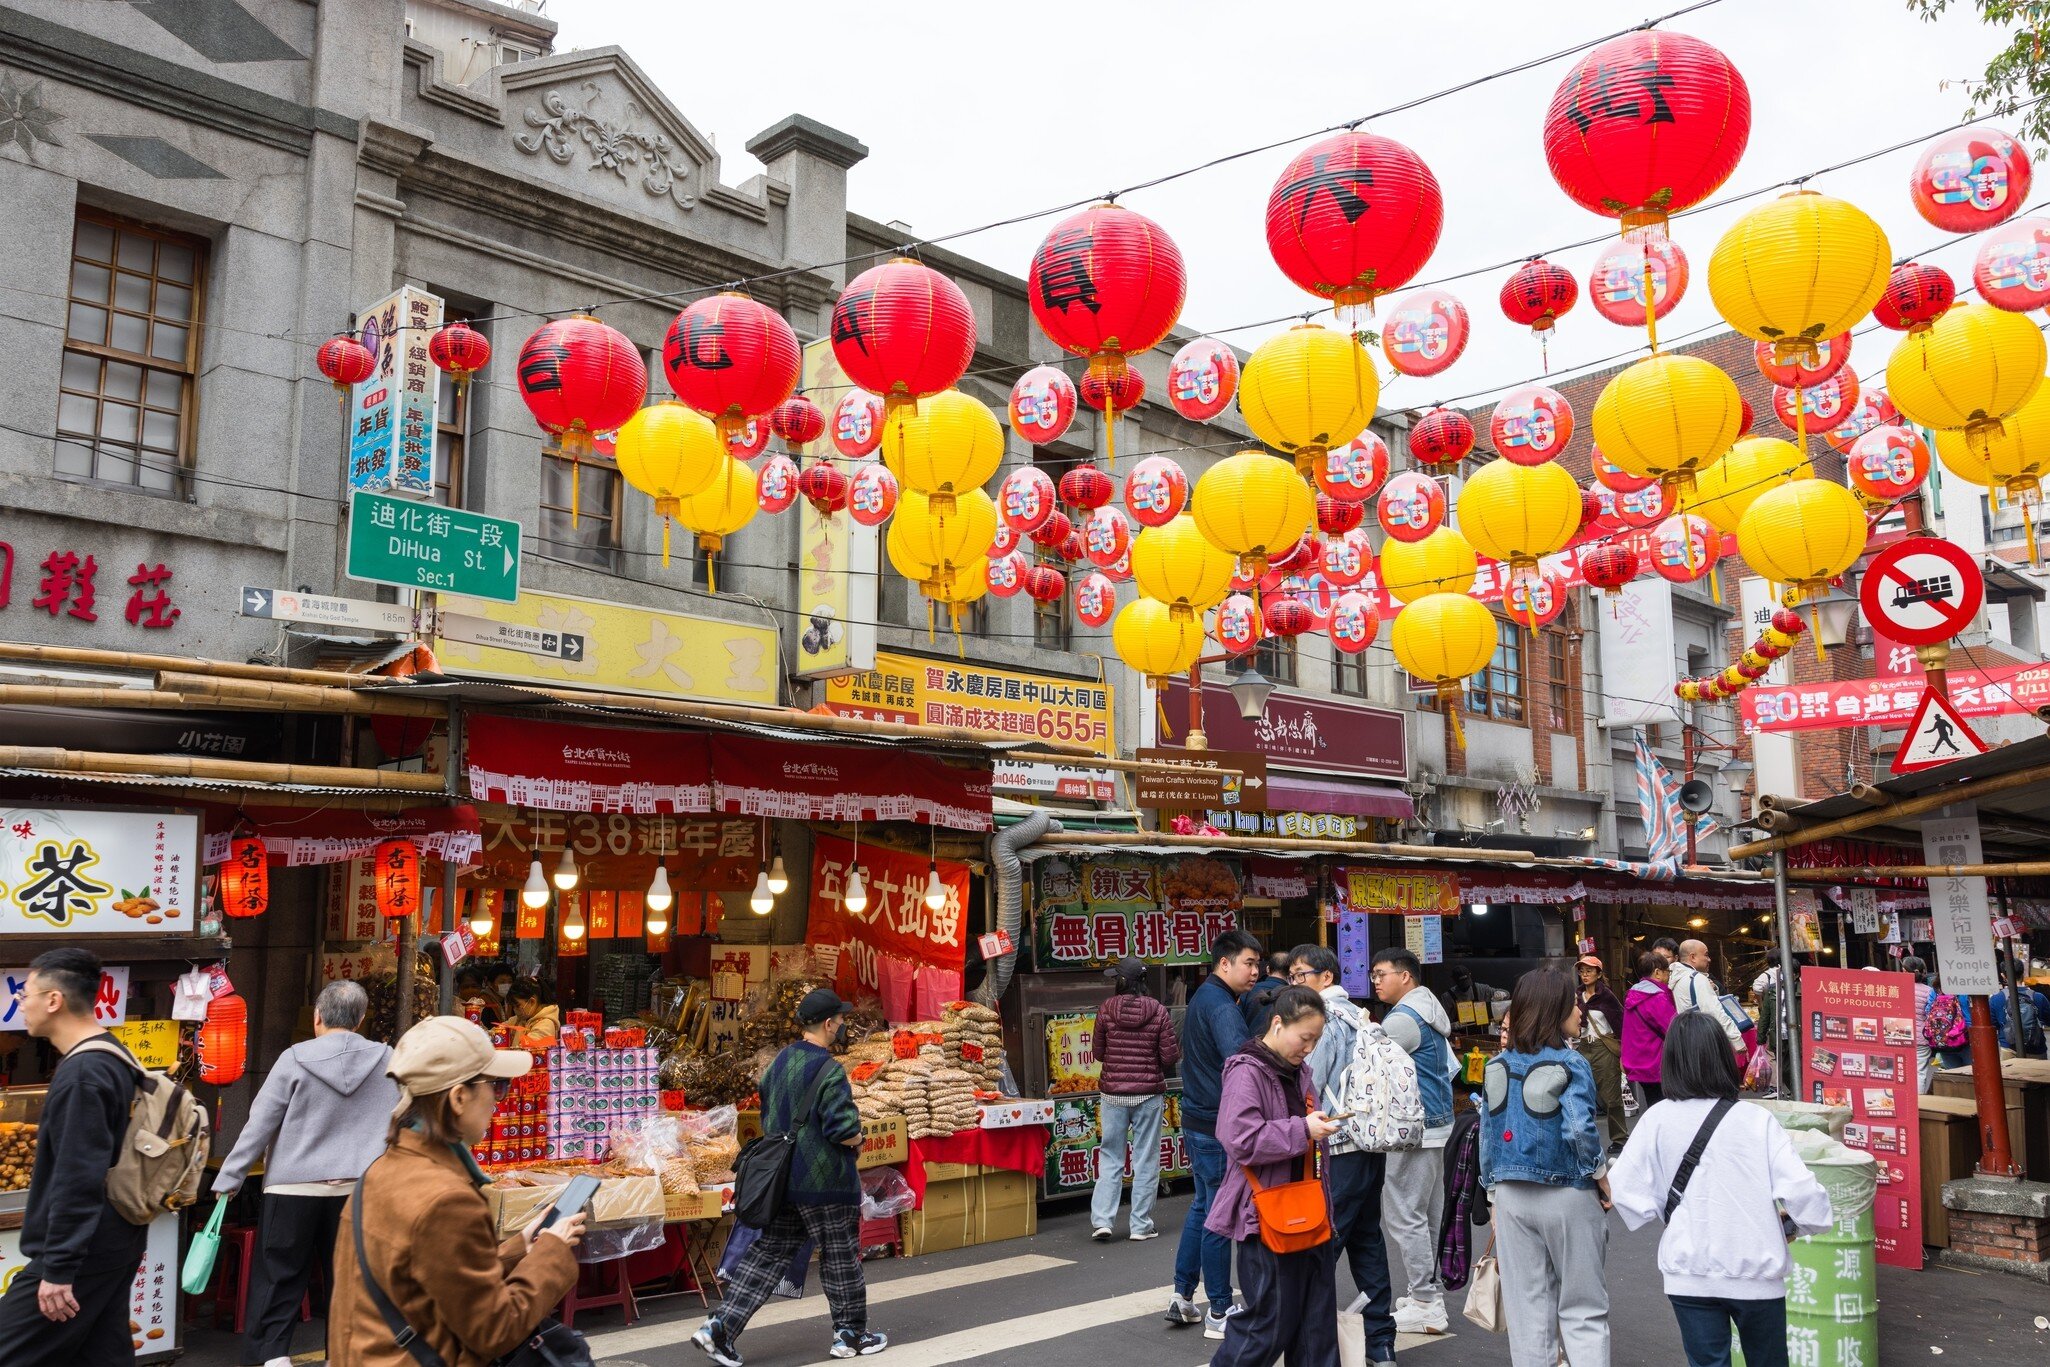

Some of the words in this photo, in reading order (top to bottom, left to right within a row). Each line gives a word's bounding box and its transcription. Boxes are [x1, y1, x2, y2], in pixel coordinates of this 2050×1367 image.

[1280, 153, 1374, 234] 大
[411, 300, 428, 331] 鮑魚
[669, 313, 733, 373] 北
[407, 346, 427, 393] 經銷商
[358, 406, 389, 437] 年貨
[404, 407, 424, 471] 年貨批發
[356, 448, 387, 477] 批發
[371, 501, 504, 549] 迪化街一段
[389, 536, 441, 563] DiHua
[463, 549, 486, 571] St.
[417, 567, 455, 588] Sec.1
[301, 598, 348, 613] 霞海城隍廟
[341, 615, 359, 623] Temple
[382, 612, 406, 624] 185m
[489, 635, 503, 643] Street
[503, 638, 524, 648] Shopping
[523, 641, 540, 649] District
[499, 626, 540, 641] 迪化街商圈
[853, 672, 915, 695] 永慶房屋
[2016, 669, 2050, 682] 2025
[851, 689, 881, 704] 先誠實
[886, 694, 915, 708] 再成交
[925, 667, 1108, 711] 賀永慶房屋中山大同區
[2017, 683, 2048, 696] 1/11
[925, 702, 1108, 743] 圓滿成交超過655戶
[177, 730, 247, 754] 小花園
[1141, 776, 1165, 784] Taiwan
[1166, 776, 1185, 784] Crafts
[1186, 777, 1218, 786] Workshop
[1206, 808, 1231, 829] Touch
[1234, 810, 1260, 834] Mango
[1263, 812, 1275, 832] ice
[1286, 815, 1355, 835] 芒果雪花冰
[1931, 834, 1971, 843] 公共自行車
[152, 821, 166, 896] 生津潤喉好滋味
[168, 853, 181, 906] 油條是絕配
[237, 842, 268, 910] 杏仁茶
[385, 847, 417, 908] 杏仁茶
[1093, 867, 1152, 900] 鐵支
[1946, 877, 1976, 955] 永樂市場
[1945, 959, 1990, 973] Yongle
[1816, 981, 1900, 999] 人氣伴手禮推薦
[1947, 976, 1992, 986] Market
[1824, 997, 1841, 1005] TOP
[1844, 998, 1892, 1009] PRODUCTS
[1060, 1033, 1071, 1048] 小
[1080, 1032, 1091, 1046] 中
[1060, 1052, 1072, 1066] 50
[1078, 1051, 1095, 1064] 100
[150, 1262, 165, 1324] 油條是絕配
